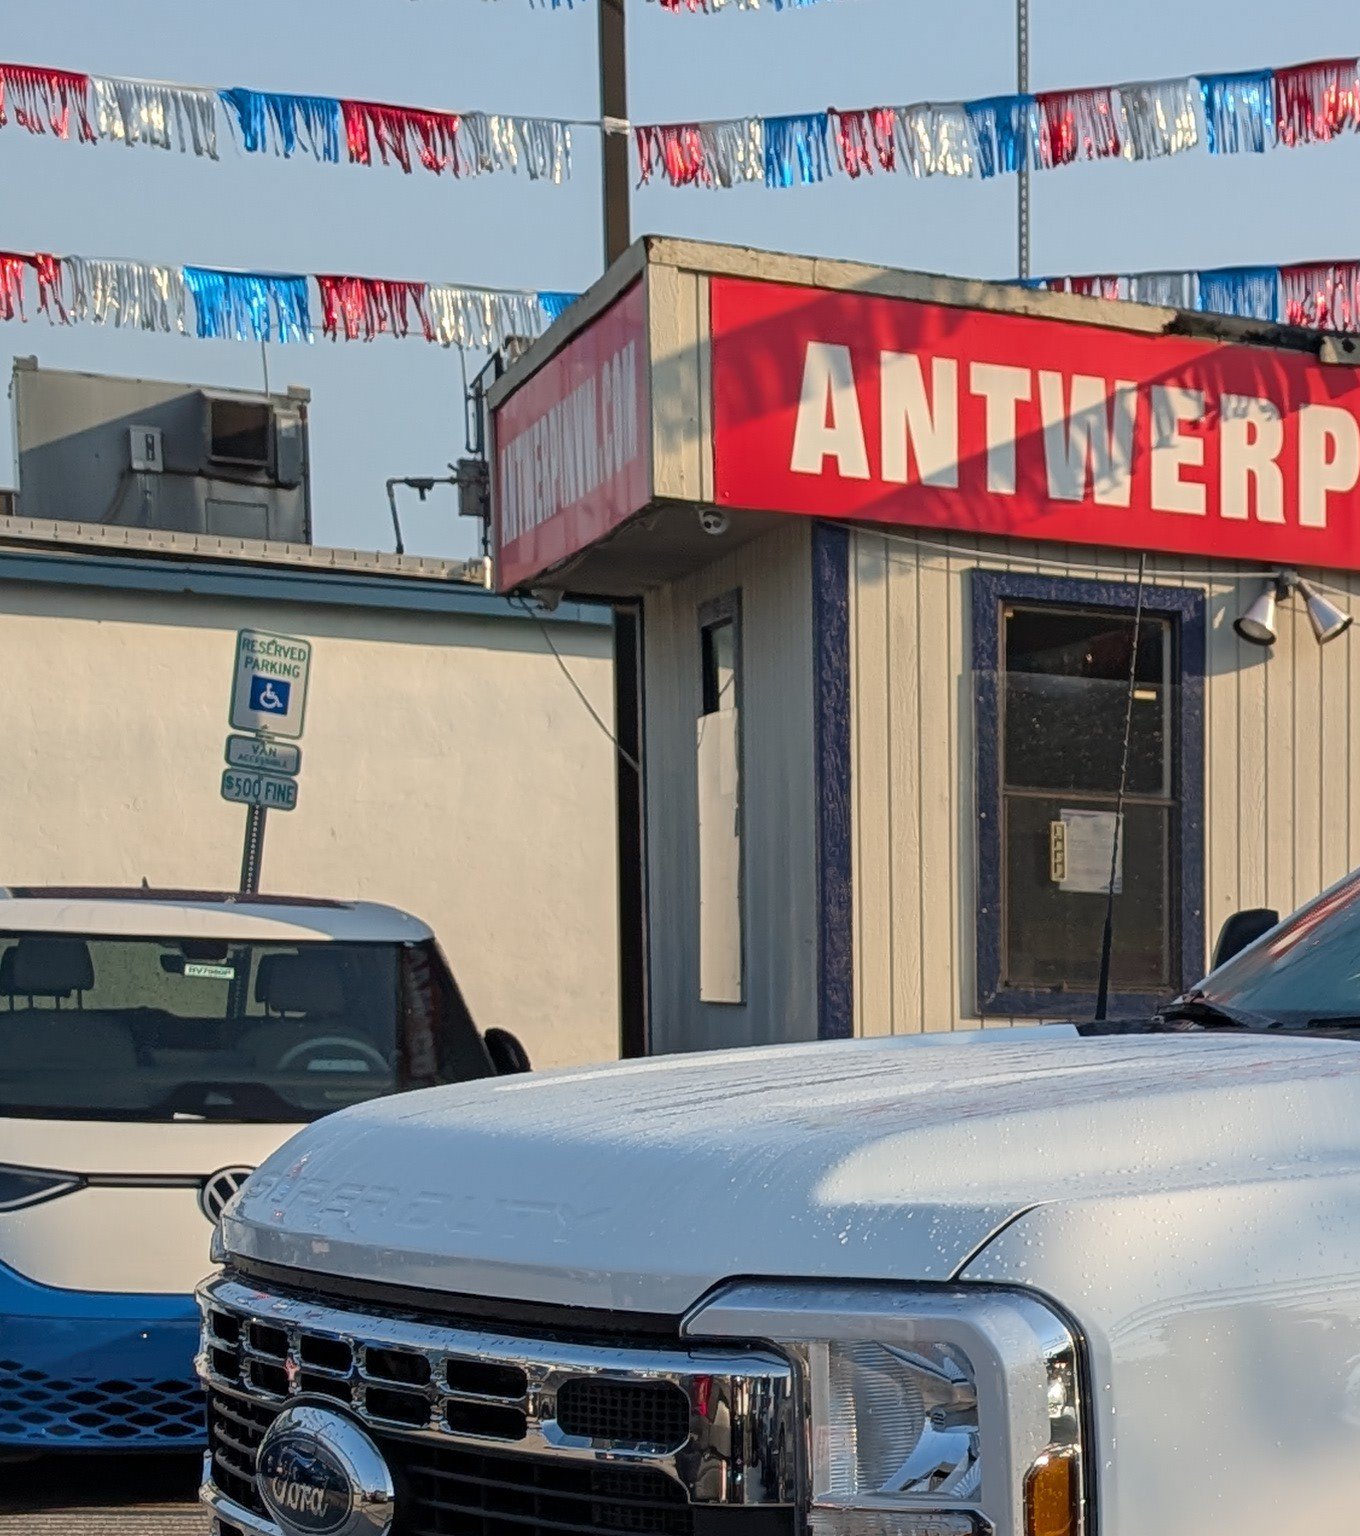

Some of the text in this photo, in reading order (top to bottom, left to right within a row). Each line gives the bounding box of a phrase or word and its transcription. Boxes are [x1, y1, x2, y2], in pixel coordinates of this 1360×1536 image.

[242, 637, 306, 662] RESERVED
[244, 657, 301, 679] PARKING
[251, 743, 278, 757] VAN
[225, 774, 295, 803] $500 FINE
[272, 1446, 330, 1518] Ford
